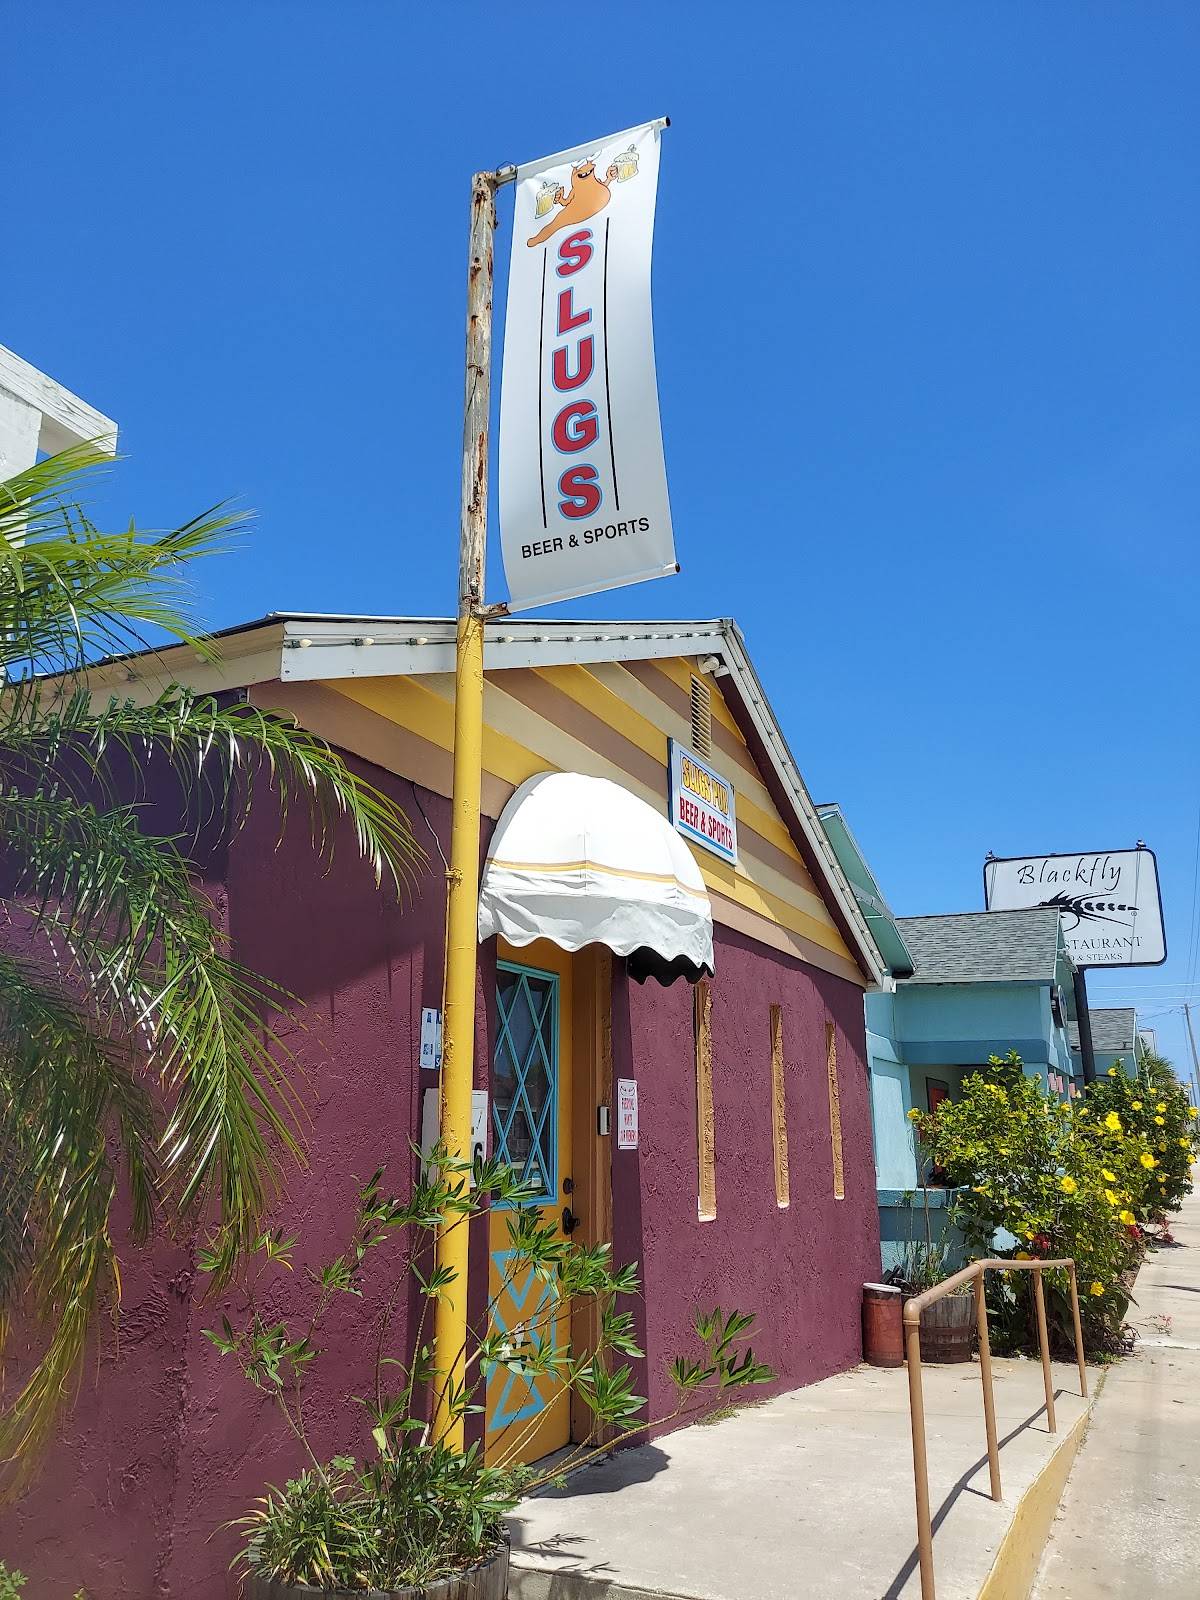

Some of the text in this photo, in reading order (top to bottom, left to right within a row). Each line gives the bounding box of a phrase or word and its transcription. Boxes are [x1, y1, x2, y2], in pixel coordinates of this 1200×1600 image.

[551, 228, 602, 520] SLUGS
[521, 517, 650, 558] BEER & SPORTS
[681, 756, 711, 803] SLUGS
[679, 796, 733, 850] BEER & SPORTS
[1017, 856, 1121, 891] Blackfly
[1064, 936, 1143, 950] STAURANT
[1087, 953, 1123, 962] STEAKS
